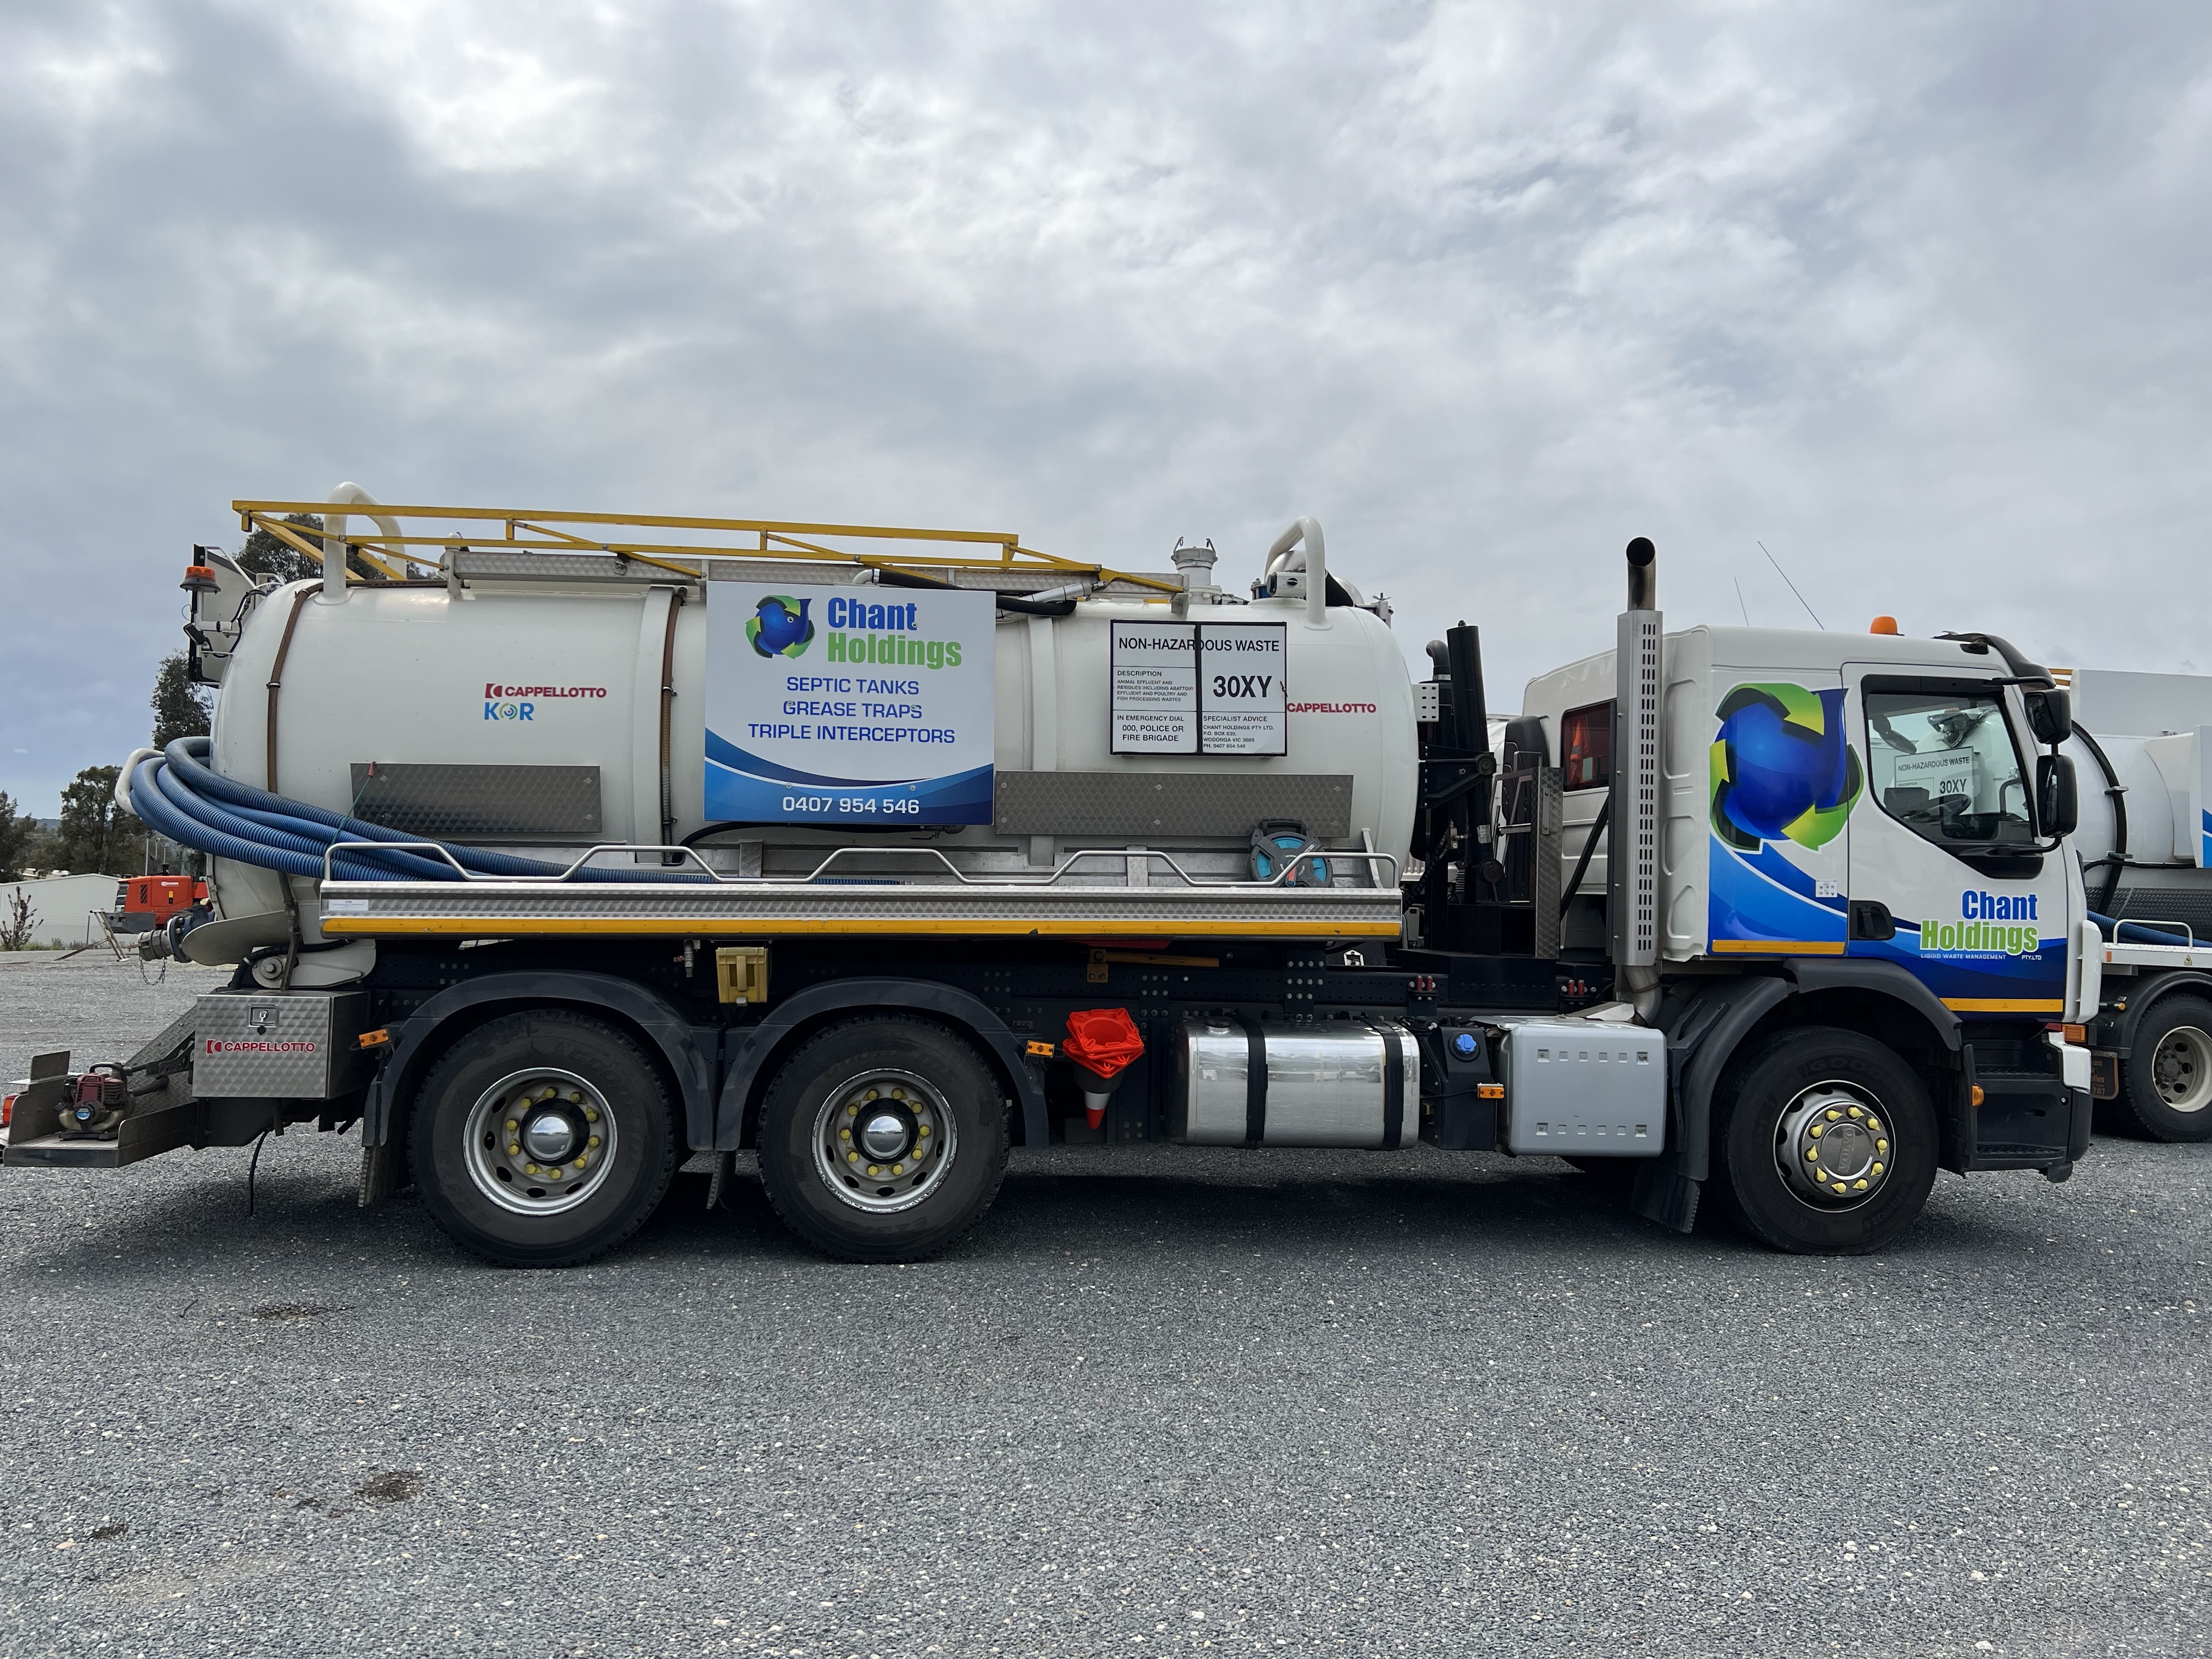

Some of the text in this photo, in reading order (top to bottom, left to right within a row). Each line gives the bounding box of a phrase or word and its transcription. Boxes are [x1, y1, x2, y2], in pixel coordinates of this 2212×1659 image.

[828, 597, 918, 630] Chant
[827, 632, 962, 670] Holdings
[1235, 640, 1279, 651] WASTE
[505, 686, 607, 698] CAPPELLOTTO
[787, 676, 919, 695] SEPTIC TANKS
[1213, 675, 1272, 698] 30XY
[783, 700, 923, 719] GREASE TRAPS
[1286, 703, 1376, 713] CAPPELLOTTO
[748, 724, 955, 743] TRIPLE INTERCEPTORS
[1898, 757, 1970, 771] NON-HAZARDOUS WASTE
[1939, 778, 1967, 794] 30XY
[782, 797, 919, 814] 0407 954 546
[1962, 890, 2038, 920] Chant
[1921, 920, 2038, 954] Holdings
[224, 1042, 315, 1053] CAPPELLOTTO
